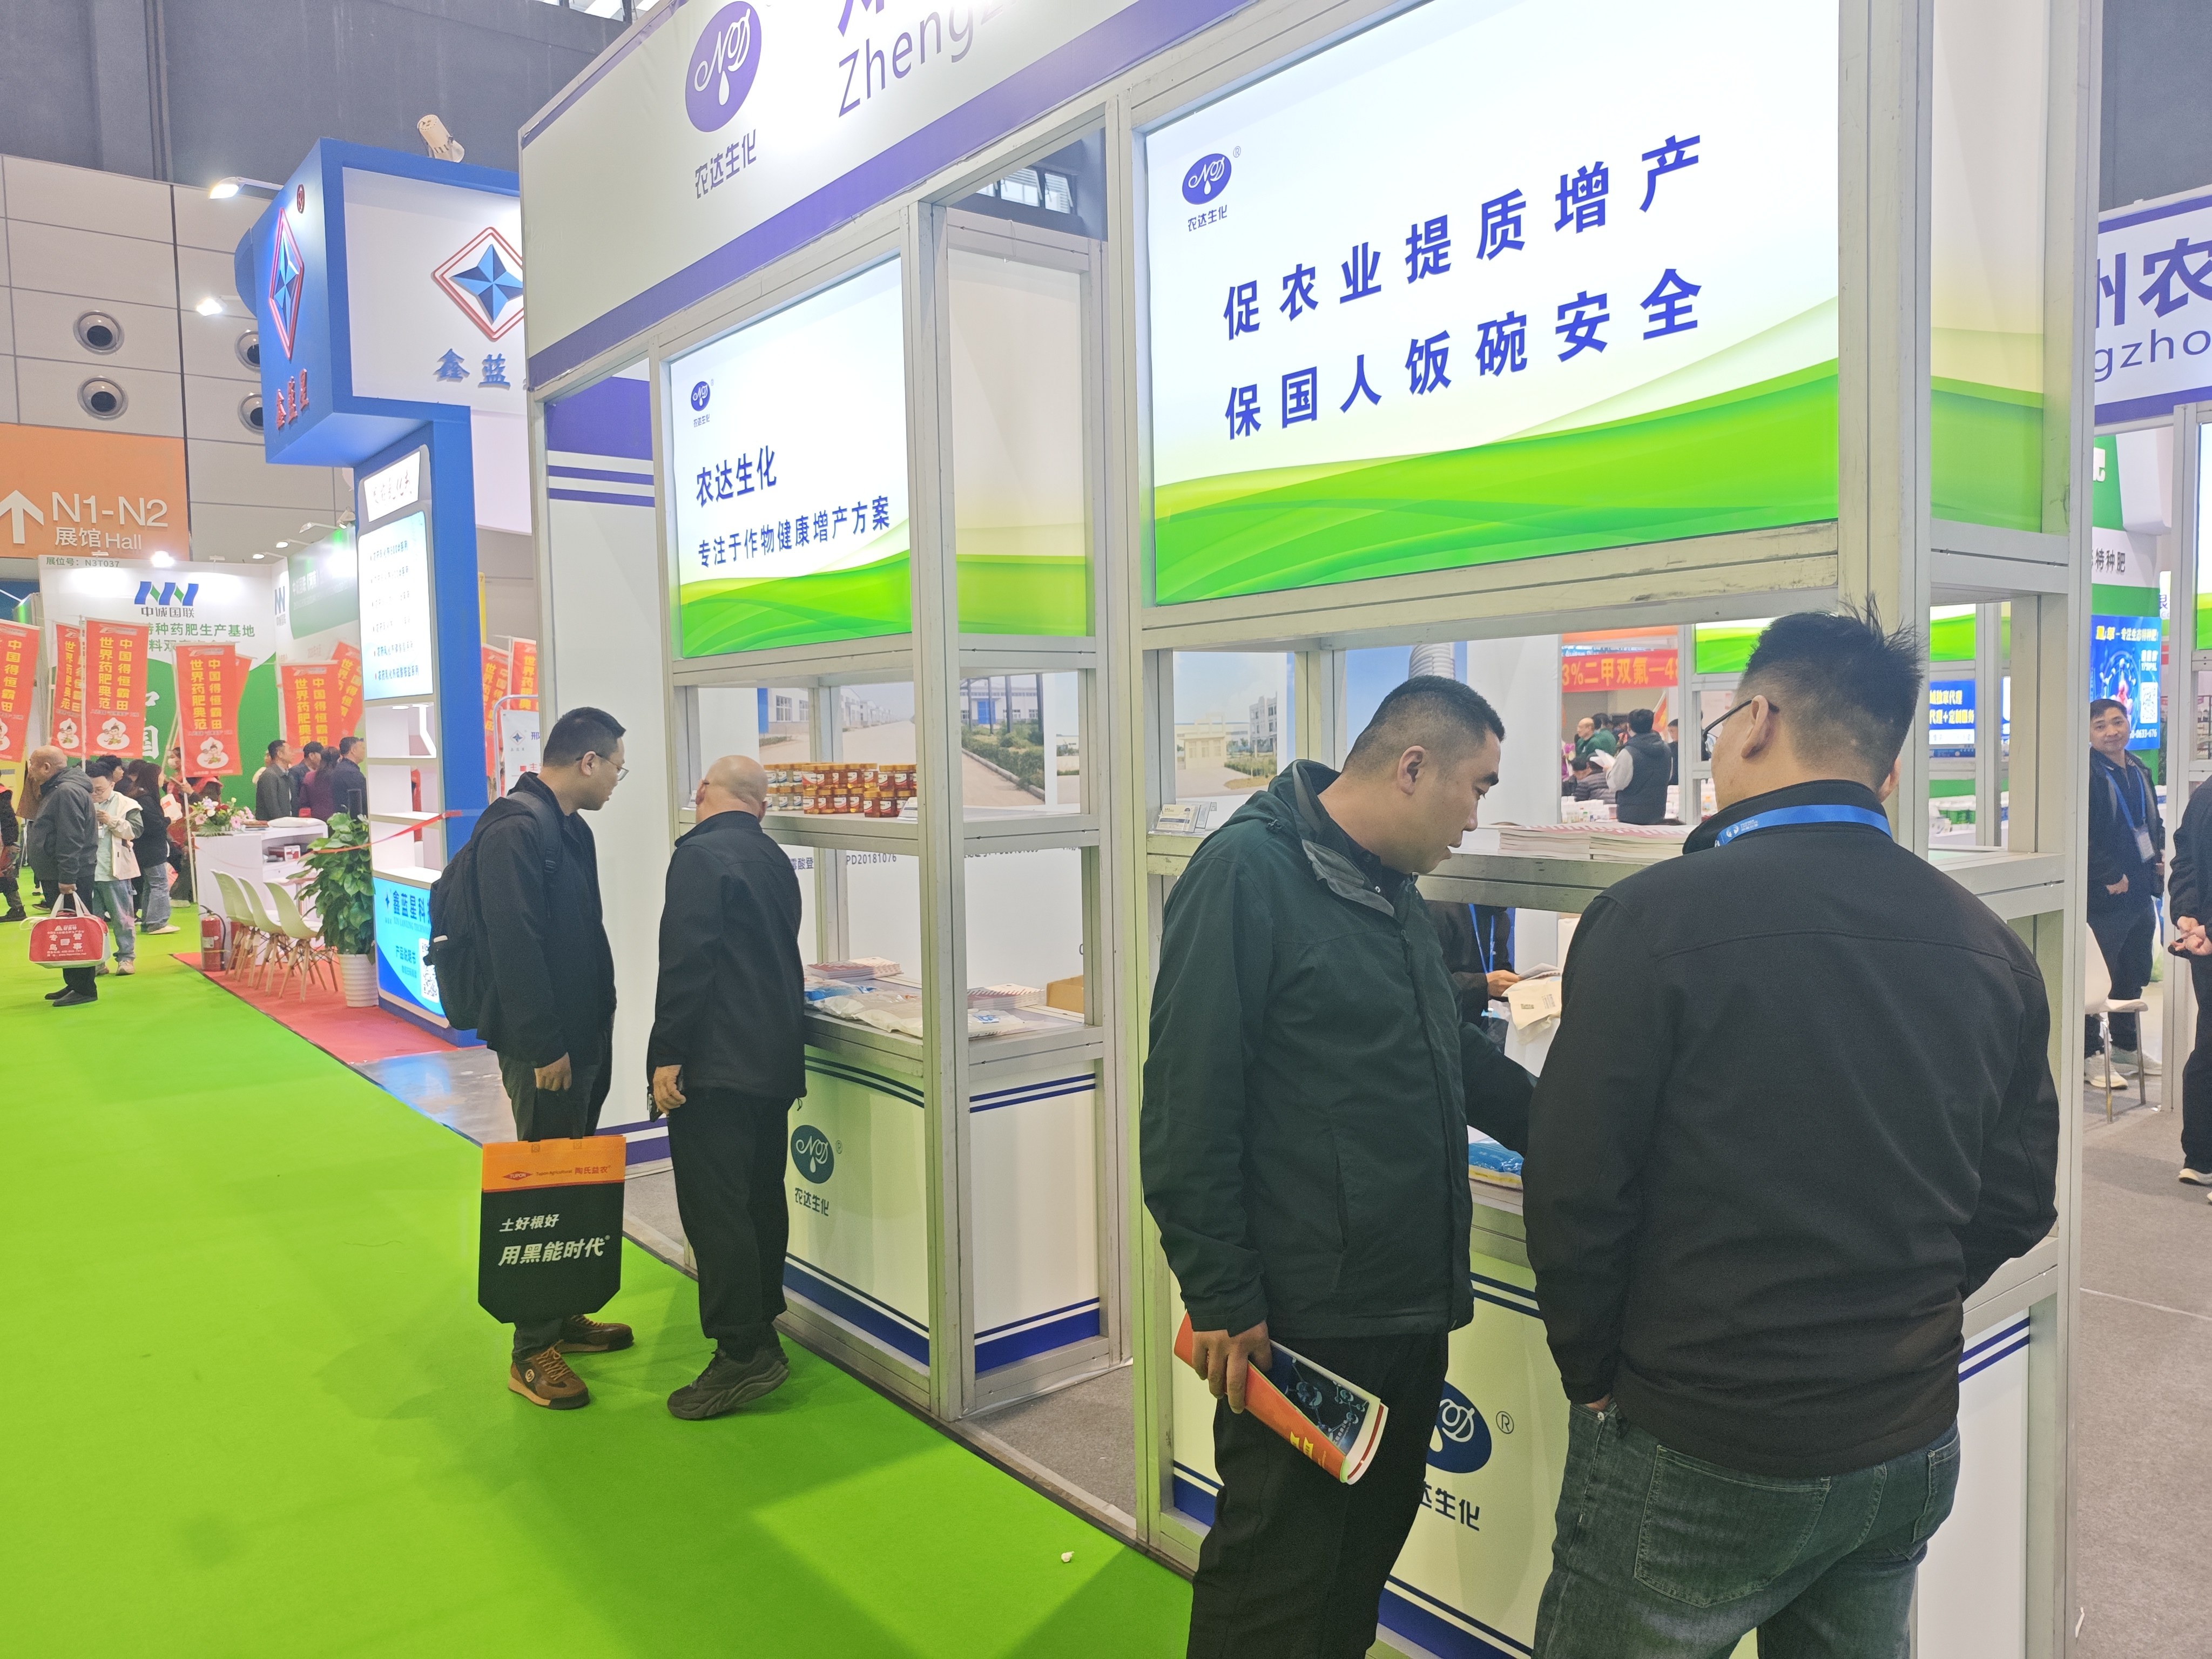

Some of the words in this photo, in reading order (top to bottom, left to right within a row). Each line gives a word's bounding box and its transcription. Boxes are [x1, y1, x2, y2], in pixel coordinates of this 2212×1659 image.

[695, 129, 757, 199] 农达生化
[1188, 205, 1228, 232] 农达生化
[1224, 134, 1701, 341] 促农业提质增产
[1224, 268, 1702, 441] 保国人饭碗安全
[693, 414, 710, 428] 农达生化
[696, 446, 777, 508] 农达生化
[52, 492, 168, 527] N1-N2
[55, 528, 100, 548] 展馆
[105, 532, 141, 550] Hall
[698, 495, 890, 568] 专注于作物健康增产方案
[85, 559, 120, 568] N3T037
[2092, 548, 2126, 573] 特种肥
[141, 606, 194, 618] 中诚国联
[98, 637, 114, 710] 世界药肥典范
[190, 659, 208, 730] 世界药肥典范
[847, 853, 896, 865] PD20181076
[393, 890, 430, 924] 鑫蓝星科
[795, 1187, 830, 1217] 农达生化
[500, 1214, 559, 1232] 土好根好
[498, 1237, 605, 1266] 用黑能时代
